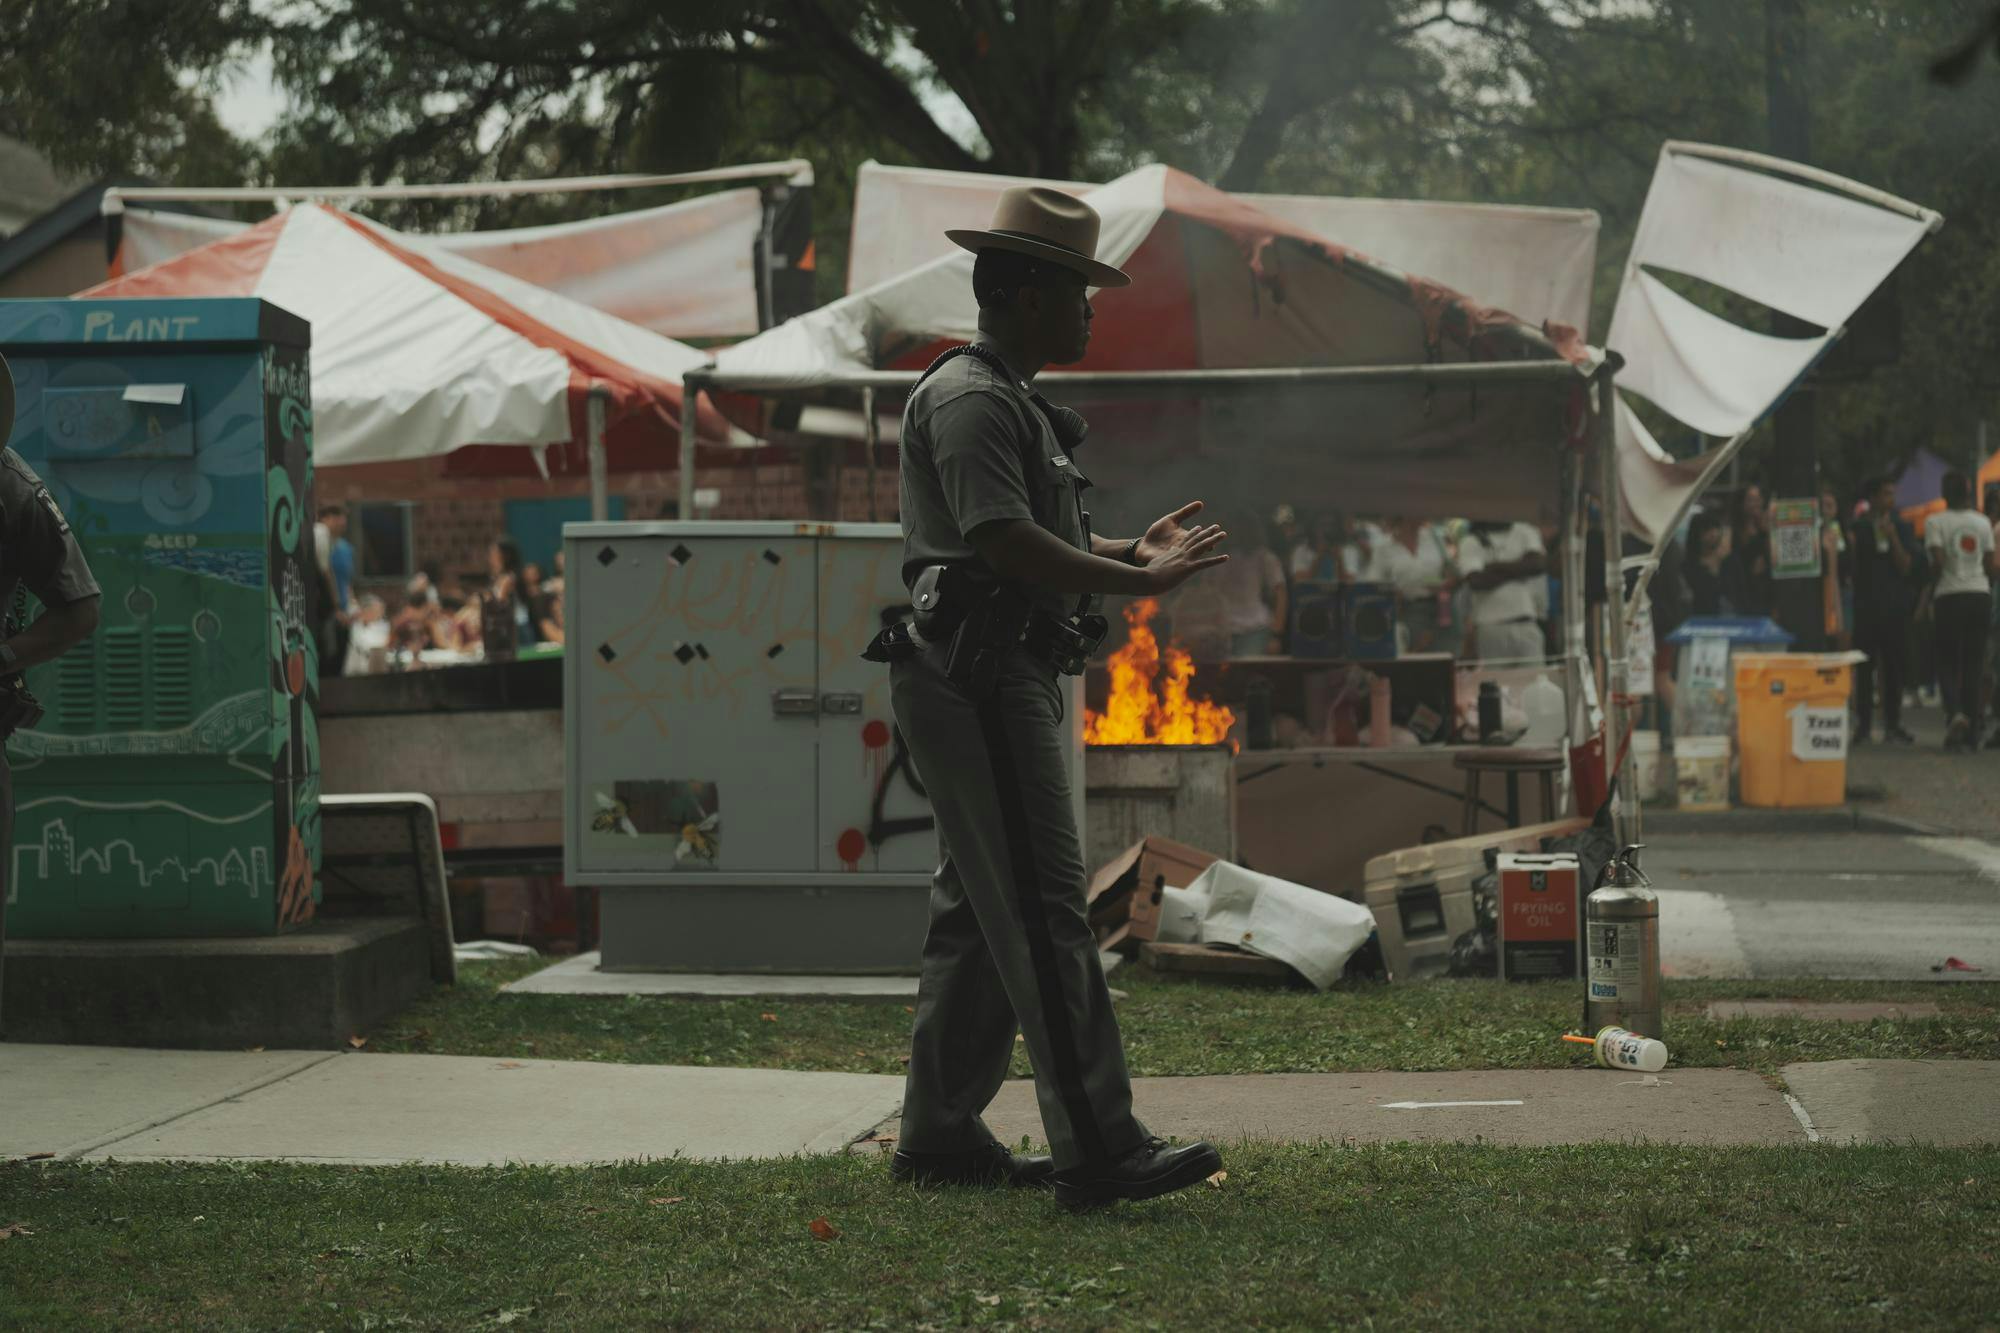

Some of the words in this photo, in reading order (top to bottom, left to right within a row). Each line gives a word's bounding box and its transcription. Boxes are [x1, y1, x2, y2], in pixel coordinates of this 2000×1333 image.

[83, 311, 199, 343] PLANT
[1512, 902, 1567, 914] FRYING
[1526, 915, 1552, 927] OIL
